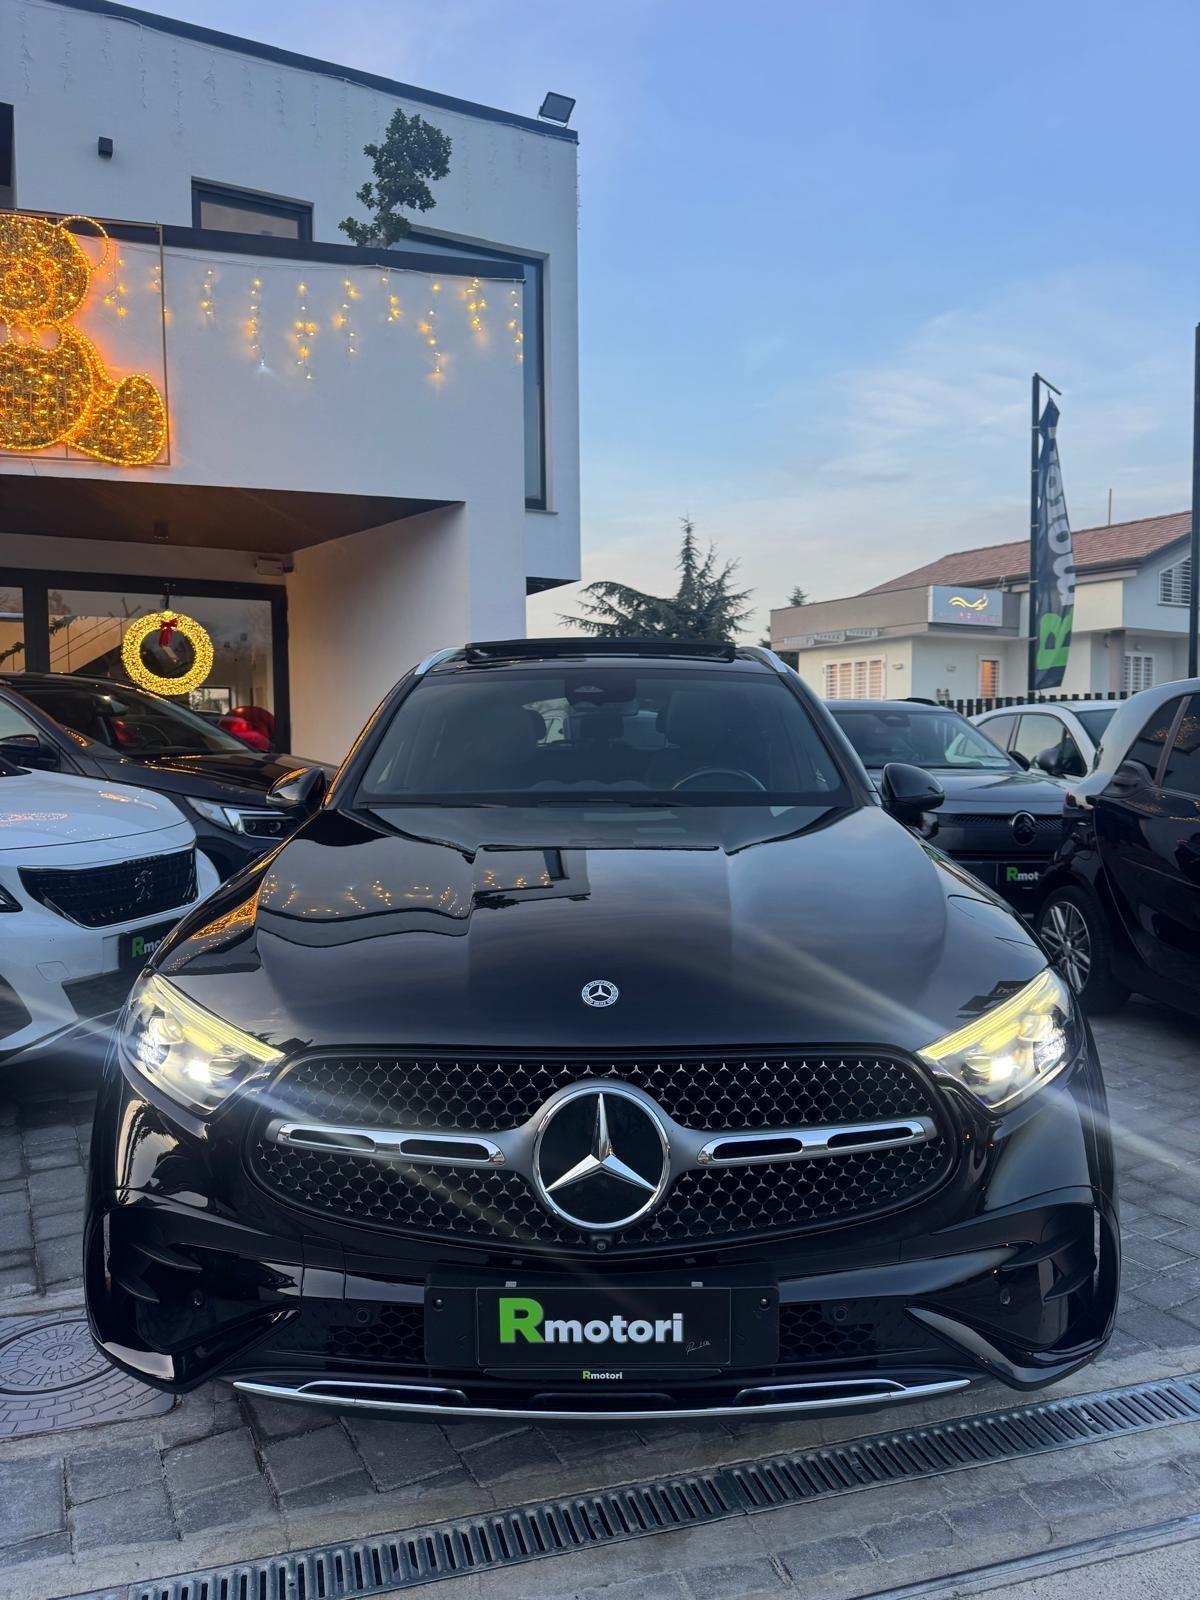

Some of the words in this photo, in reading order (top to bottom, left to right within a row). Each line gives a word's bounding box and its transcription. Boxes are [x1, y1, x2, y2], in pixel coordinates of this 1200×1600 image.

[132, 936, 165, 958] Rmo
[499, 1298, 684, 1343] Rmotori
[582, 1370, 623, 1380] Rmotori
